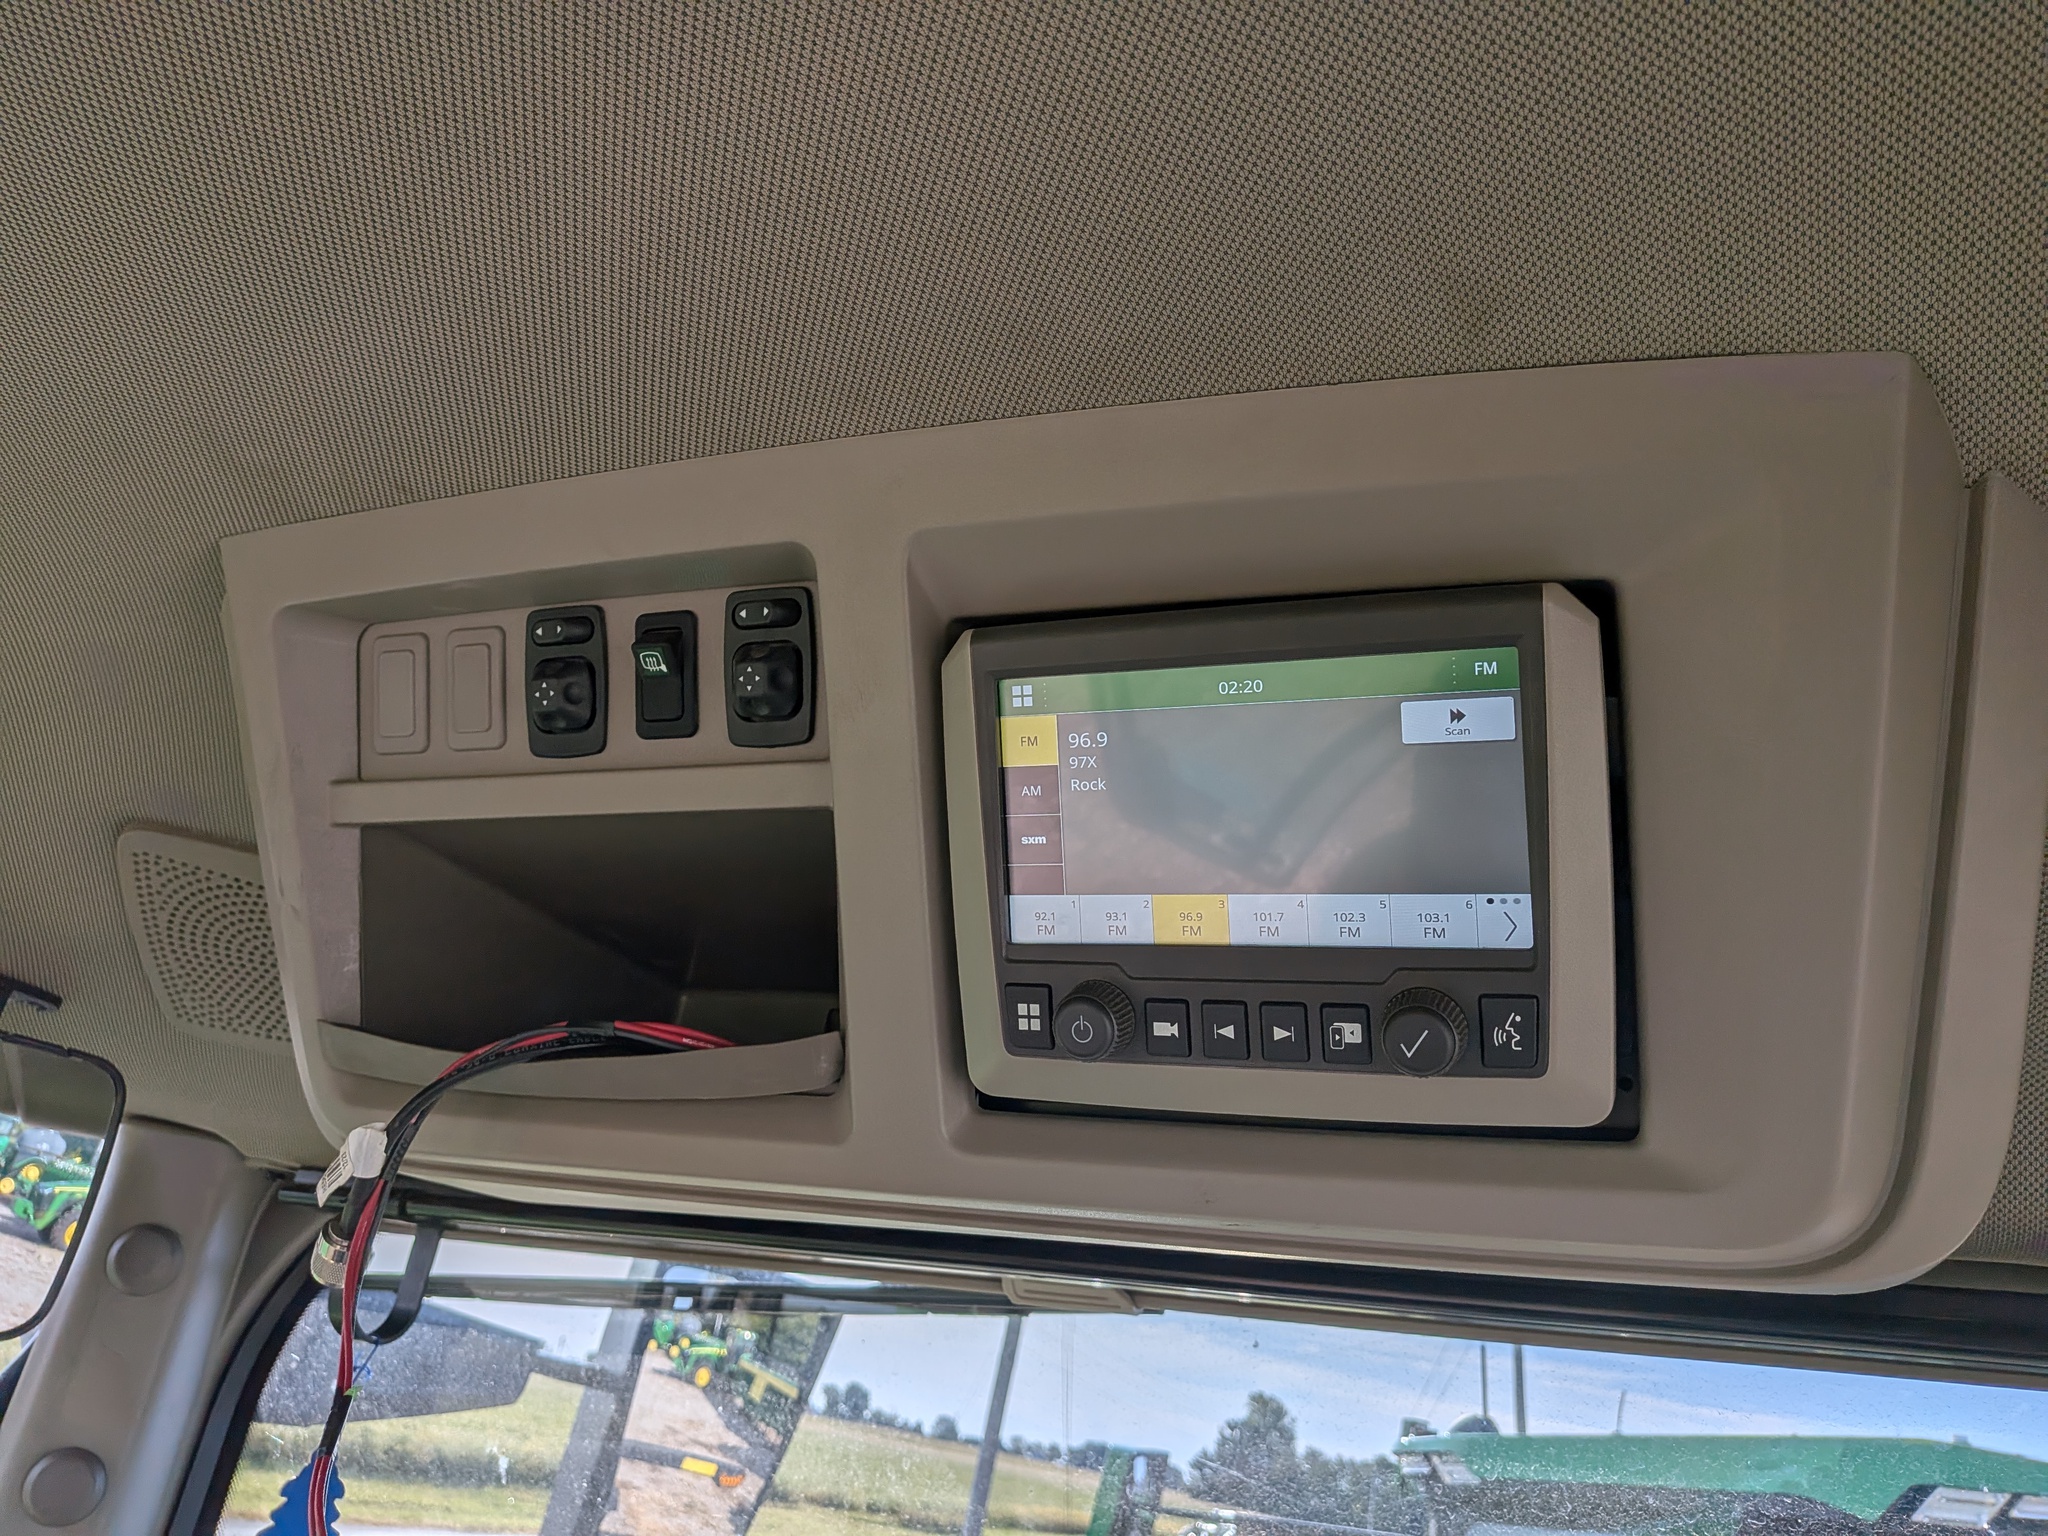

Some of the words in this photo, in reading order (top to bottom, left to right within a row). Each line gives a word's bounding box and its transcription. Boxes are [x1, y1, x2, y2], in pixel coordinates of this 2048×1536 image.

[1474, 661, 1498, 676] FM
[1218, 679, 1264, 695] 02:20
[1444, 727, 1471, 736] Scan
[1020, 735, 1039, 747] FM
[1068, 731, 1108, 749] 96.9
[1069, 755, 1097, 769] 97X
[1070, 777, 1107, 791] Rock
[1021, 785, 1042, 797] AM
[1021, 835, 1047, 845] sxm
[1071, 899, 1077, 909] 1
[1142, 899, 1150, 909] 2
[1218, 899, 1226, 909] 3
[1296, 900, 1305, 909] 4
[1379, 900, 1387, 909] 5
[1465, 900, 1473, 910] 6
[1034, 911, 1056, 922] 92.1
[1105, 911, 1128, 922] 93.1
[1179, 912, 1203, 922] 96.9
[1252, 912, 1285, 922] 101.7
[1333, 912, 1367, 923] 102.3
[1416, 912, 1450, 923] 103.1
[1037, 924, 1056, 936] FM
[1108, 924, 1128, 936] FM
[1182, 925, 1202, 937] FM
[1258, 926, 1280, 938] FM
[1339, 926, 1361, 938] FM
[1423, 927, 1446, 939] FM
